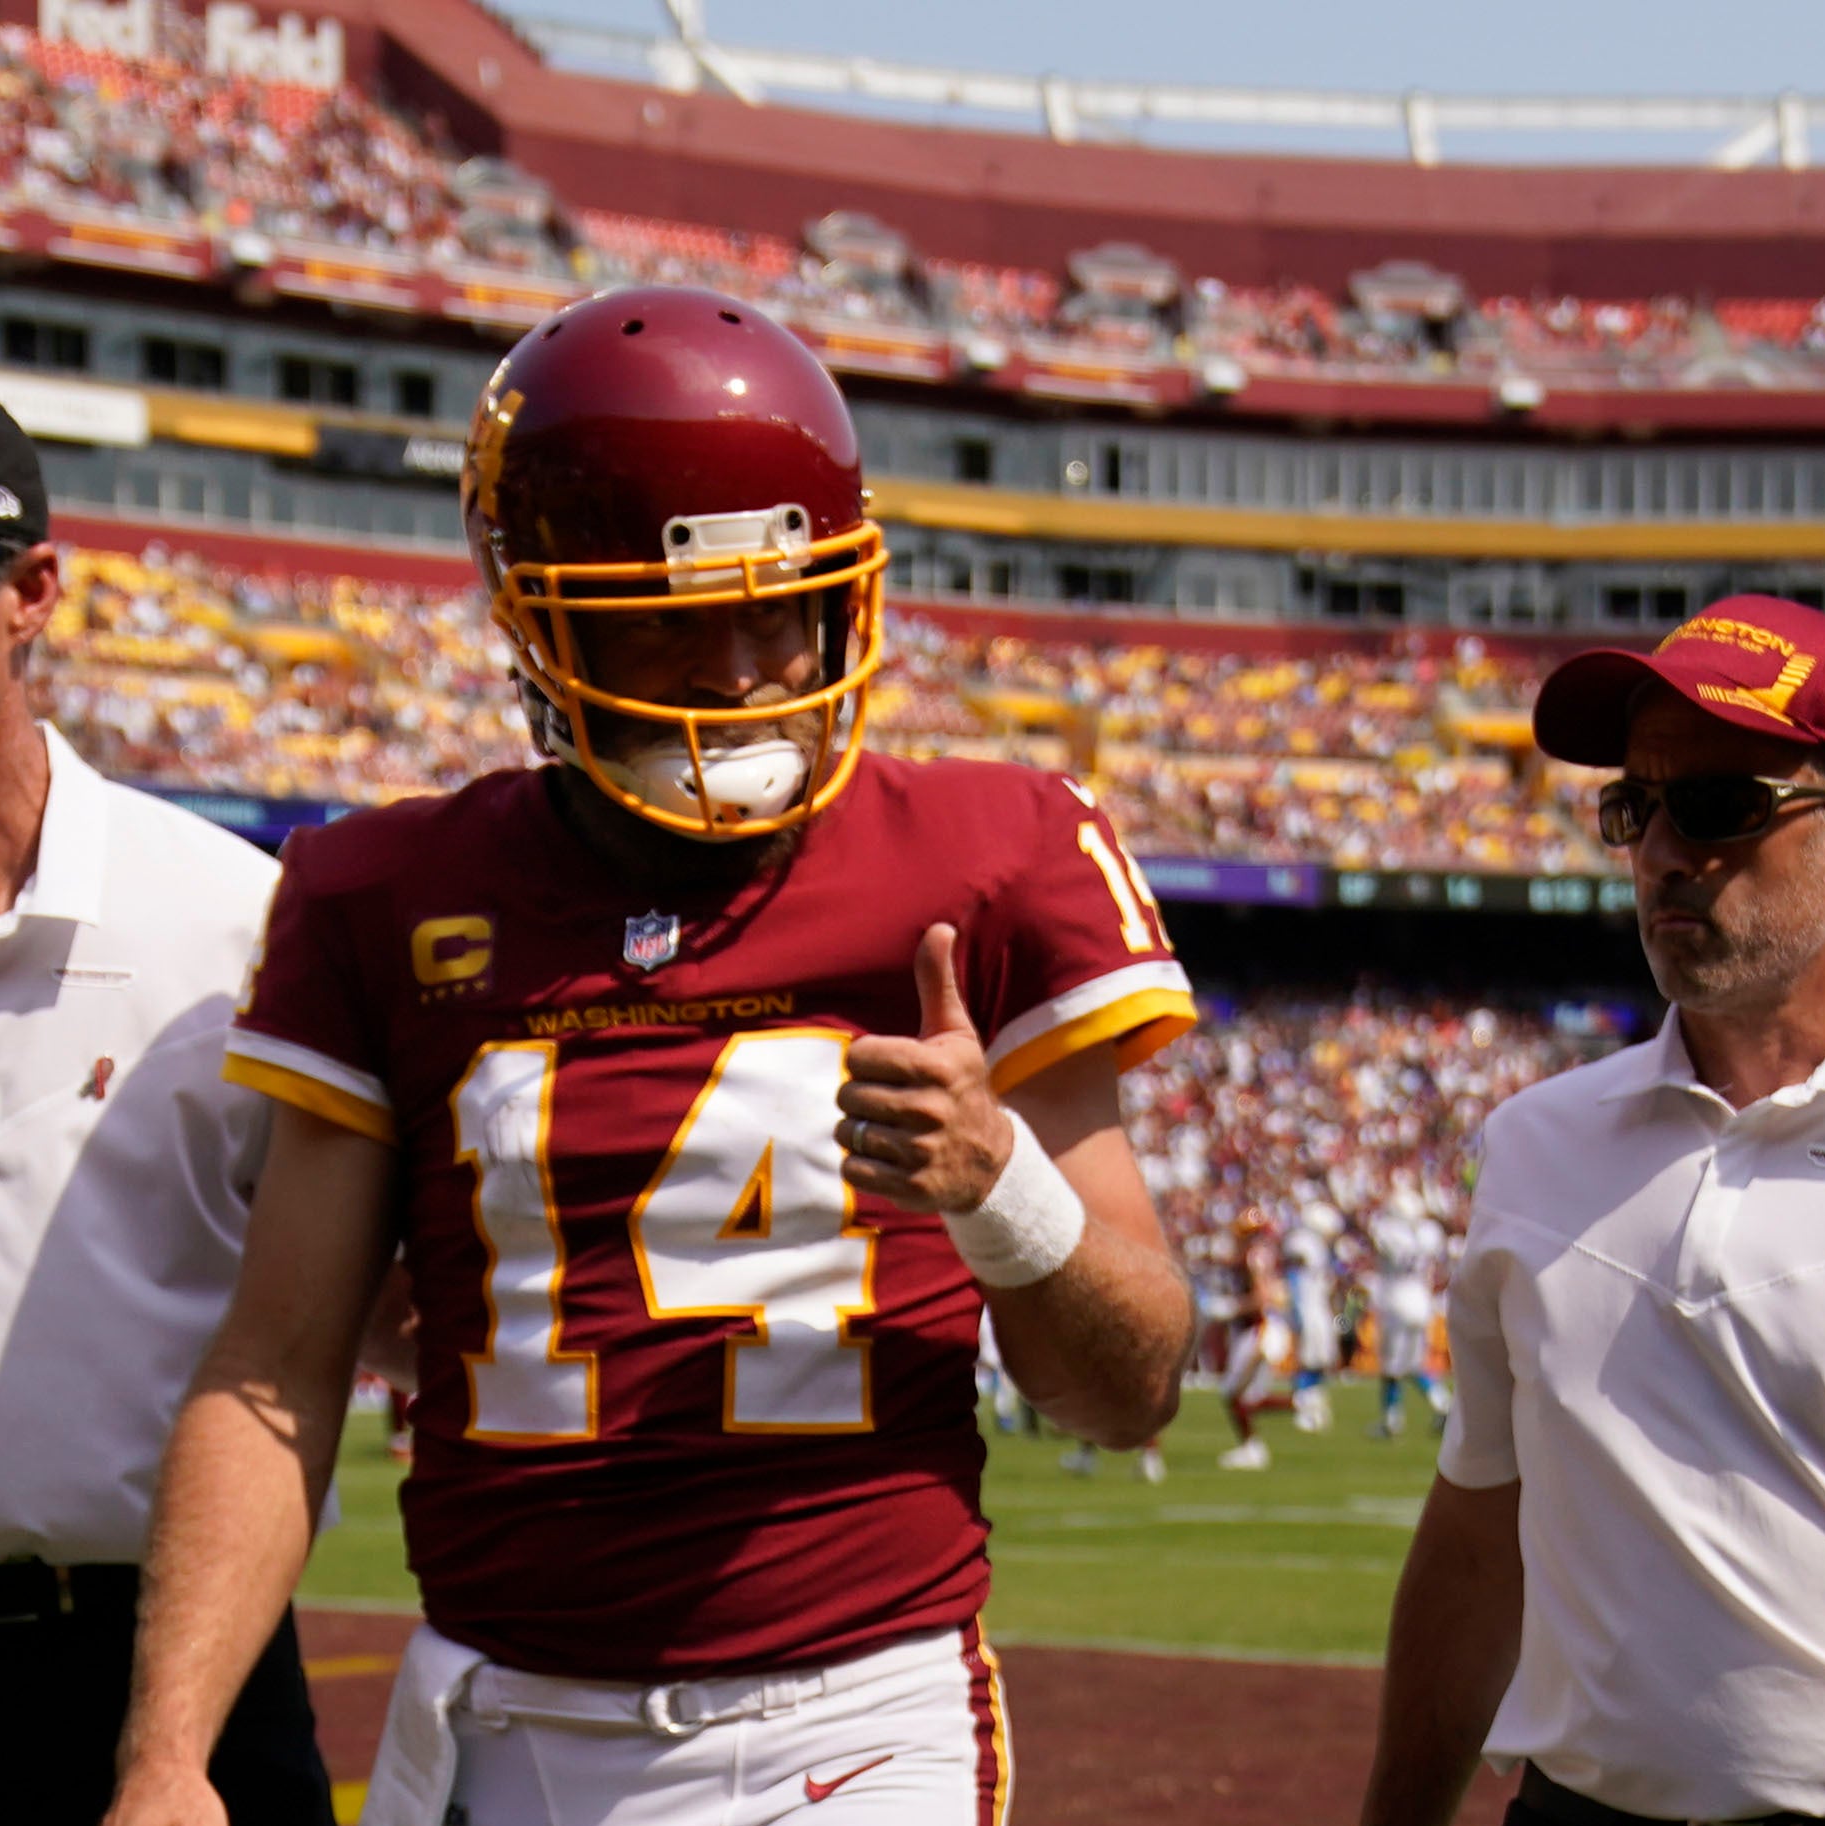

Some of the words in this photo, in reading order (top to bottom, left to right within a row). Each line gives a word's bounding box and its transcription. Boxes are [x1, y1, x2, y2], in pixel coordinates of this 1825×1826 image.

[205, 2, 345, 92] Field
[1651, 616, 1797, 659] INGTON
[411, 915, 493, 985] C
[525, 992, 795, 1036] WASHINGTON
[448, 1027, 879, 1444] 14
